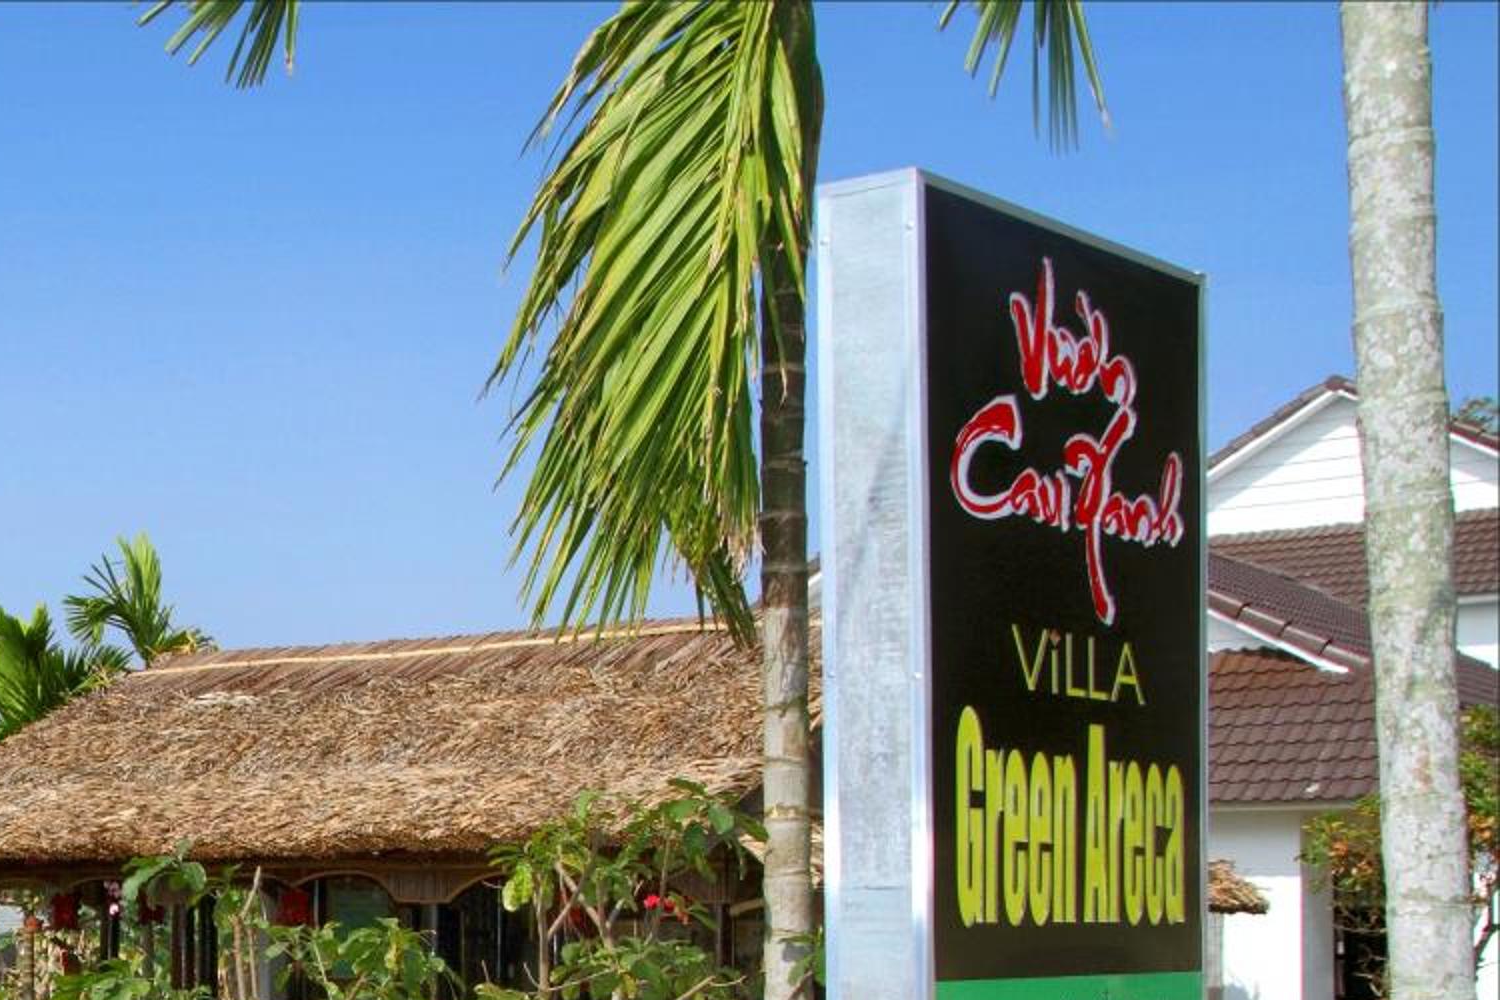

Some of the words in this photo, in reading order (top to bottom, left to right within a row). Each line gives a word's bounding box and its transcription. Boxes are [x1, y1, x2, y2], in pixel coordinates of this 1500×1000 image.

[951, 395, 1070, 532] Cau
[1063, 405, 1184, 626] Xanh
[956, 705, 1077, 926] Green
[1083, 723, 1186, 926] Areca
